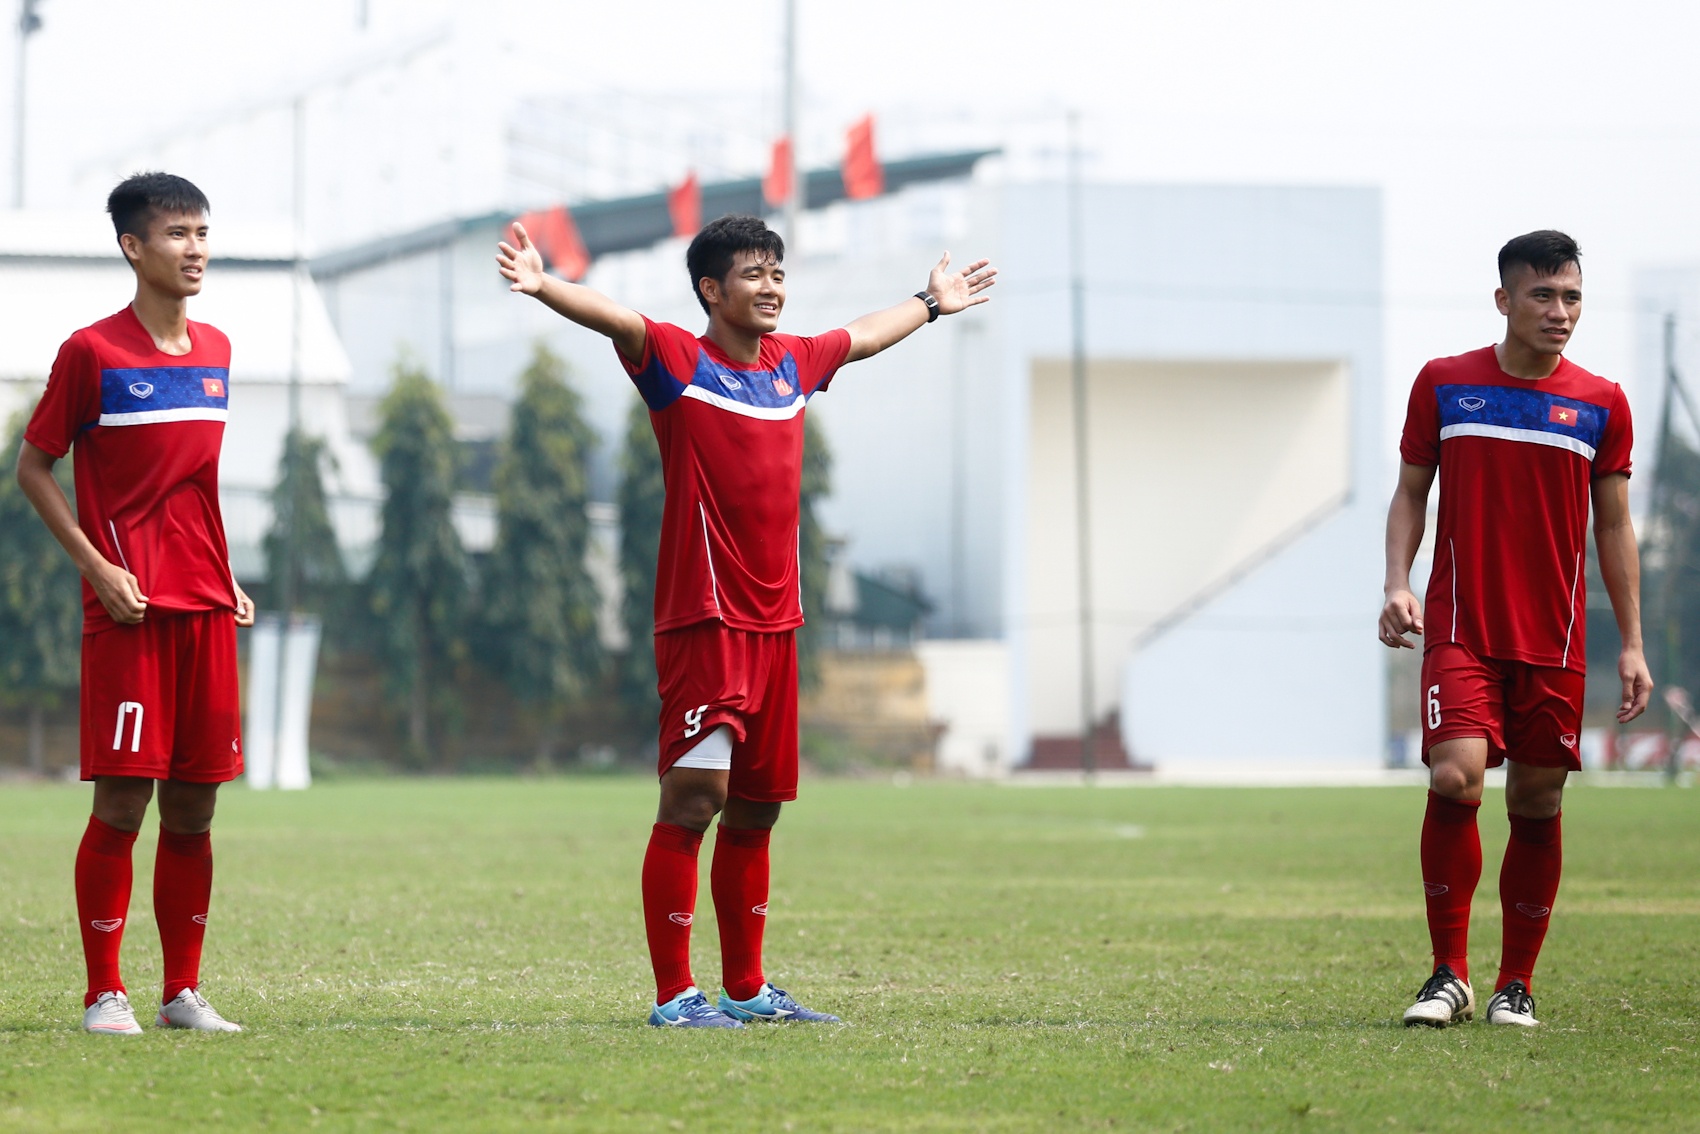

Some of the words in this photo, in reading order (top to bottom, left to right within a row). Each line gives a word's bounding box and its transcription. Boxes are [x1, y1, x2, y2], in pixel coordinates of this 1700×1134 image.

[112, 701, 144, 752] 17
[683, 704, 709, 738] 9
[1427, 684, 1442, 730] 6
